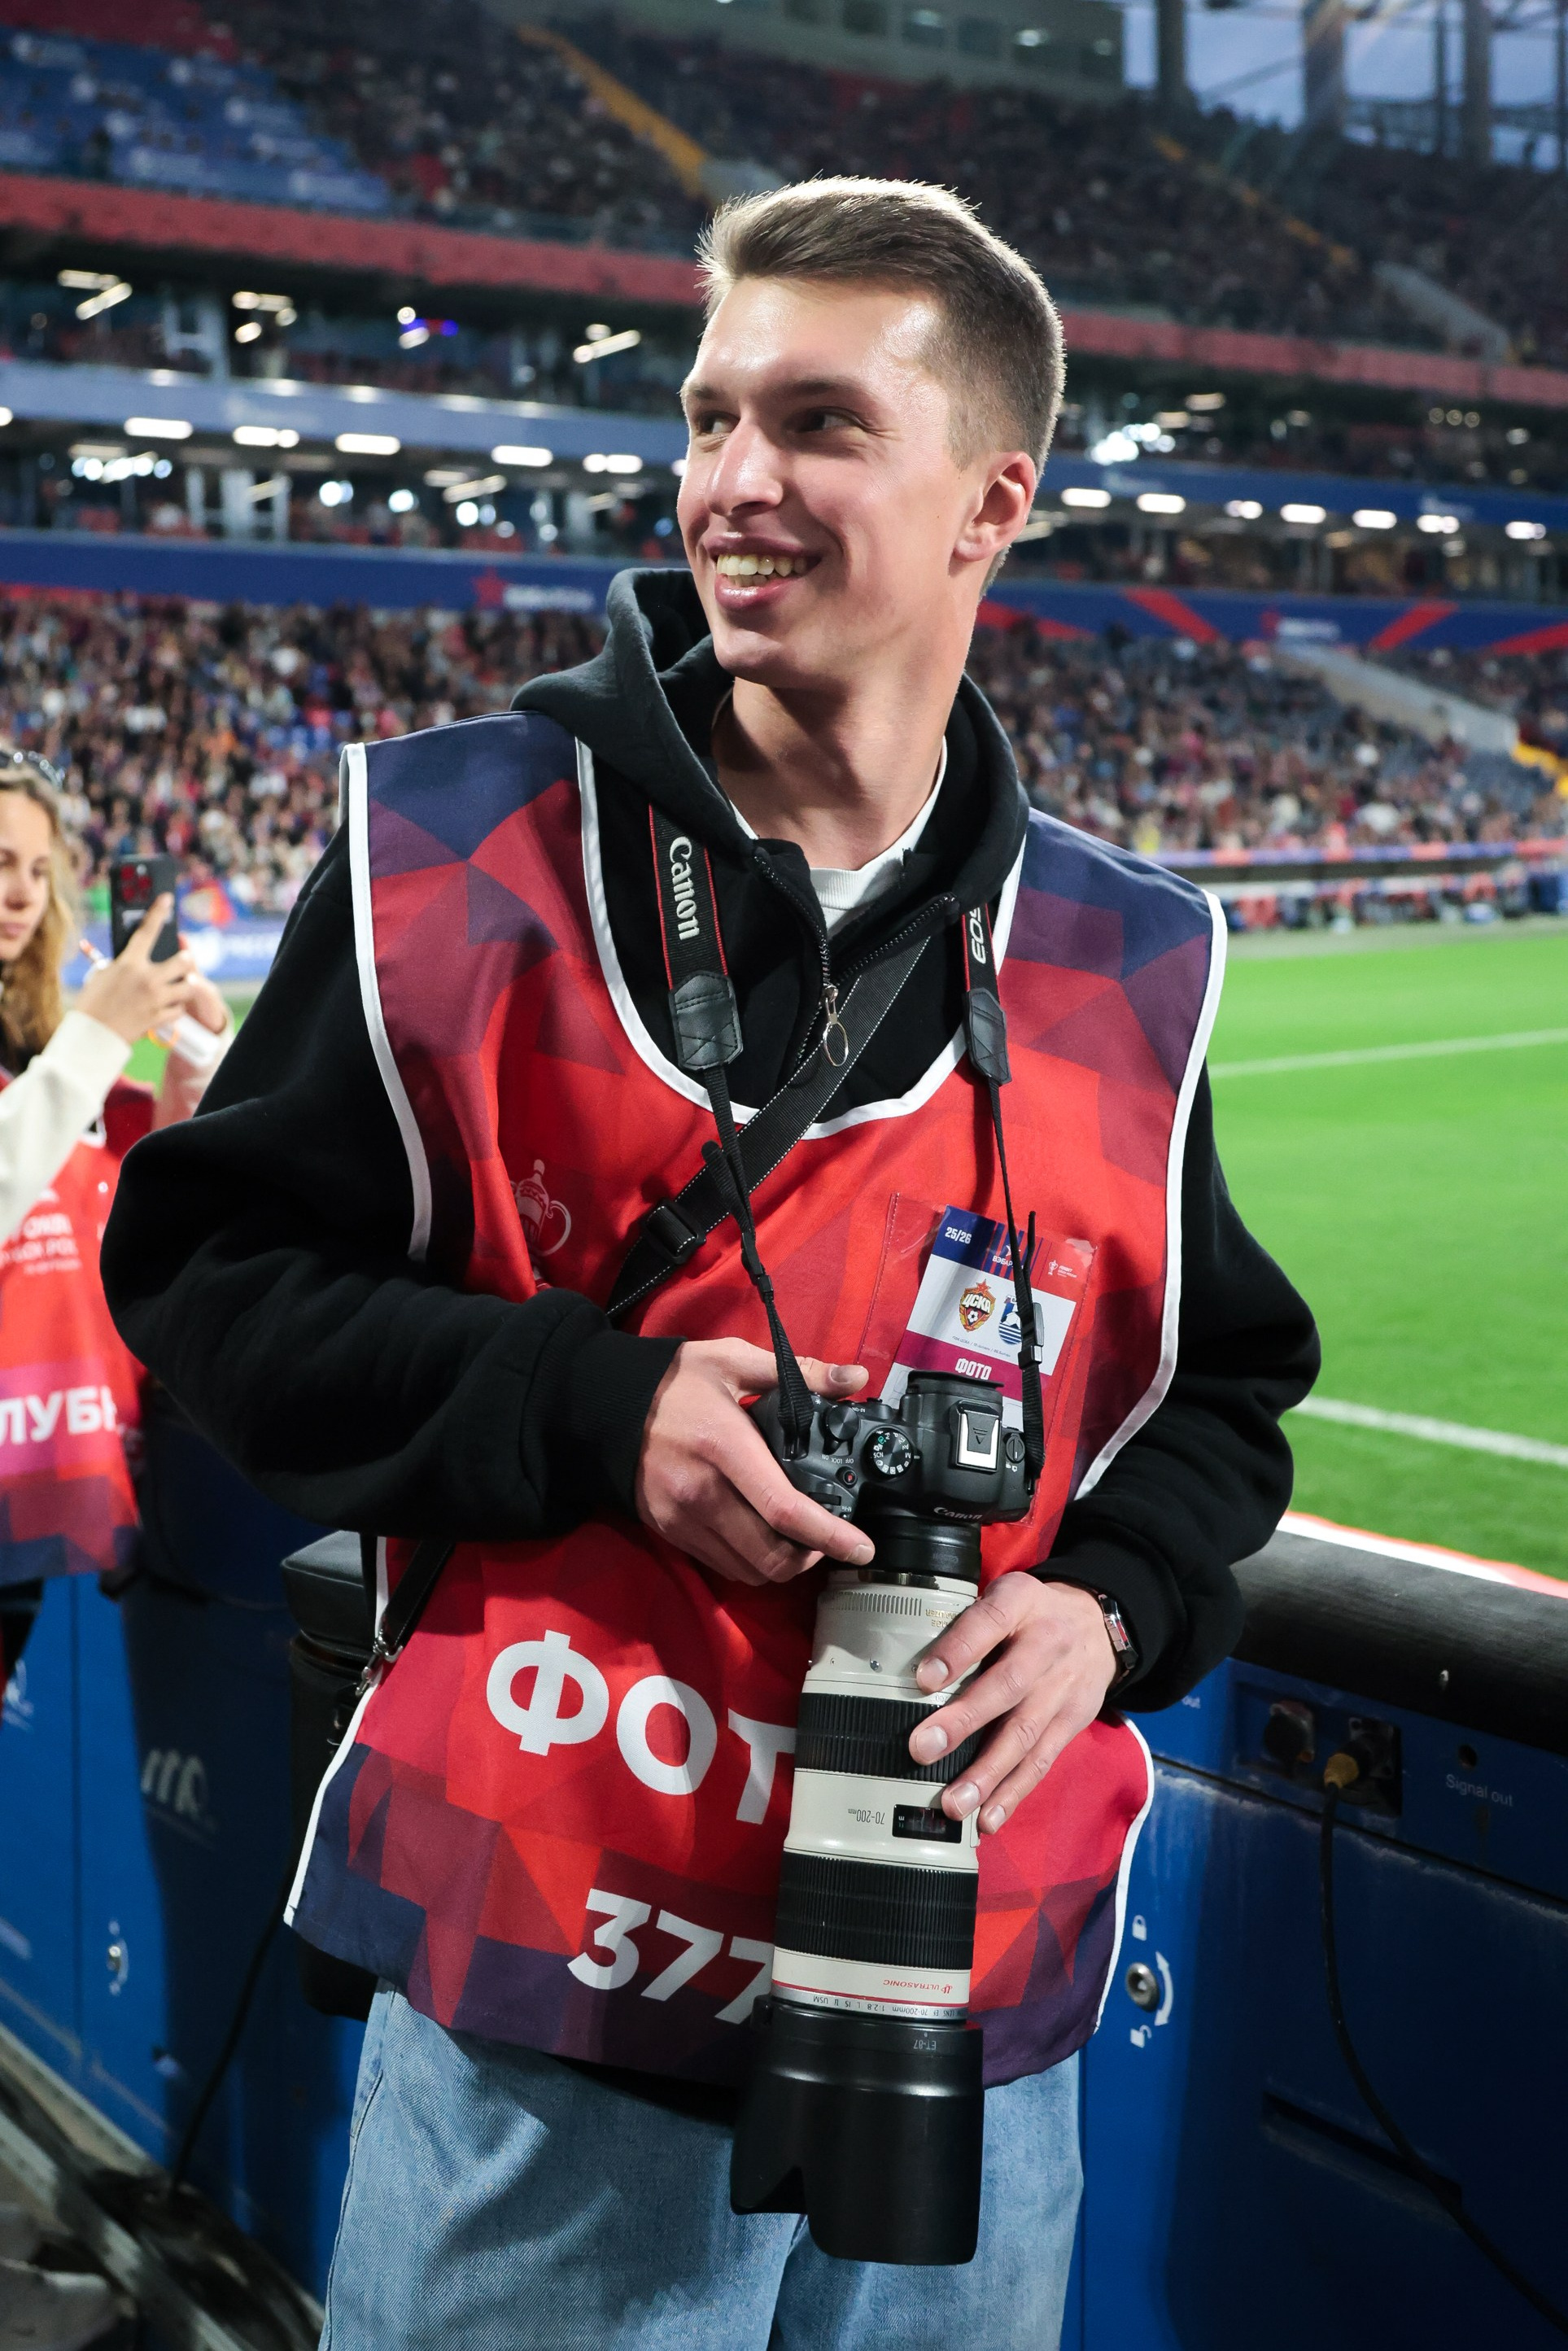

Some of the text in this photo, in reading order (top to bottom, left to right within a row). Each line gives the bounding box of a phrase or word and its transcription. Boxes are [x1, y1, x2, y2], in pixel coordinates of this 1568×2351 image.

[670, 836, 700, 941] Canon
[945, 1226, 972, 1244] 25/26
[961, 1293, 991, 1314] ЦСКА
[954, 1357, 992, 1380] ФОТО
[0, 1385, 117, 1446] ЛУБ
[933, 1506, 983, 1519] Canon
[1445, 1774, 1513, 1807] Signal out
[567, 1888, 774, 2025] 377
[883, 1979, 940, 1990] ULTRASONIC
[813, 1996, 828, 2004] USM
[892, 2007, 928, 2017] 70-200mm
[913, 2039, 937, 2050] ET-87
